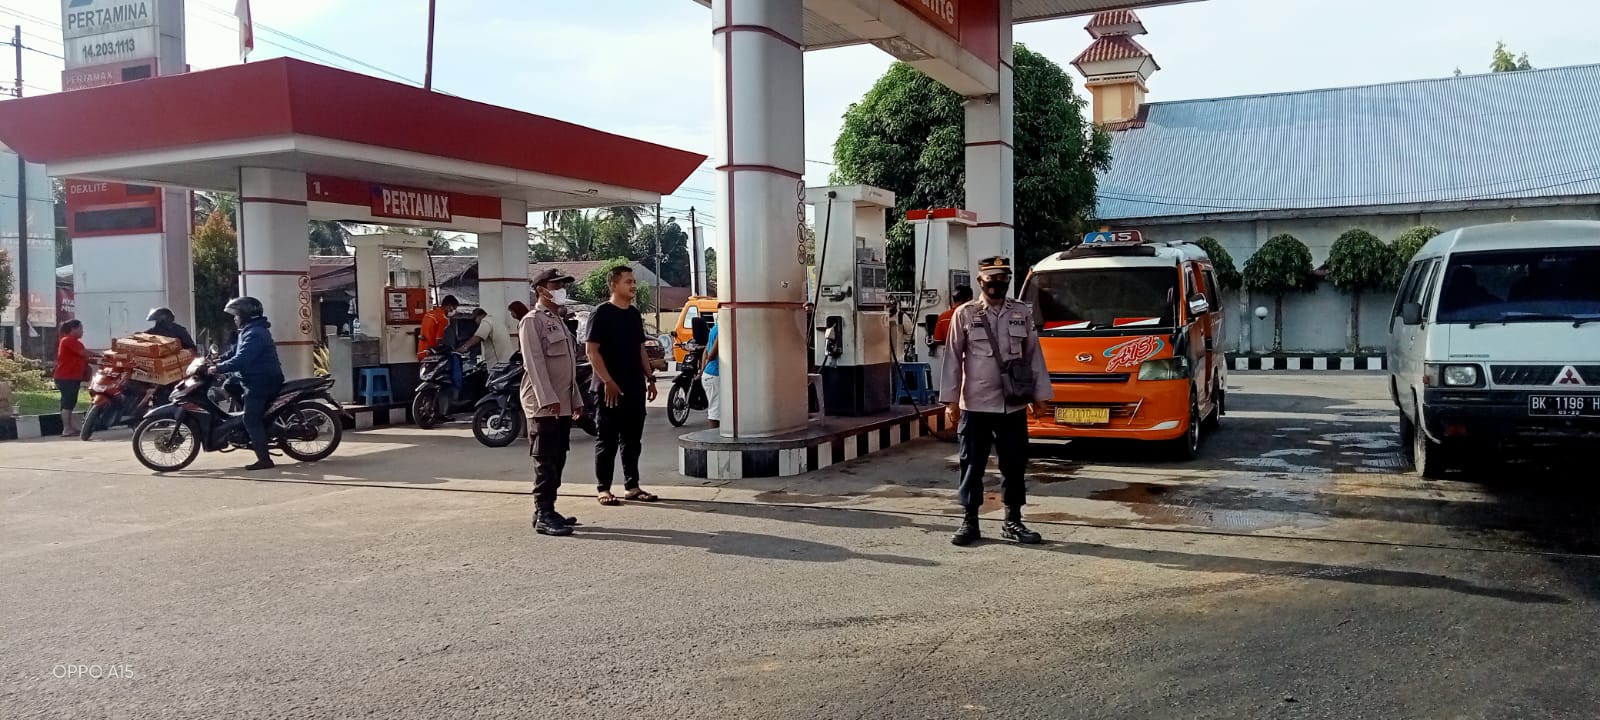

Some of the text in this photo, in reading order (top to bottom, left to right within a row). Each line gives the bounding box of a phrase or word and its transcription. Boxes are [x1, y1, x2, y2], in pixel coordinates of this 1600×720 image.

[68, 2, 148, 30] PERTAMINA
[82, 38, 135, 59] 14.203.1113
[70, 183, 108, 194] DEXLITE
[382, 188, 450, 219] PERTAMAX
[1092, 232, 1132, 243] A15
[1105, 335, 1155, 373] A15
[1532, 396, 1546, 409] BK
[1556, 396, 1584, 410] 1196
